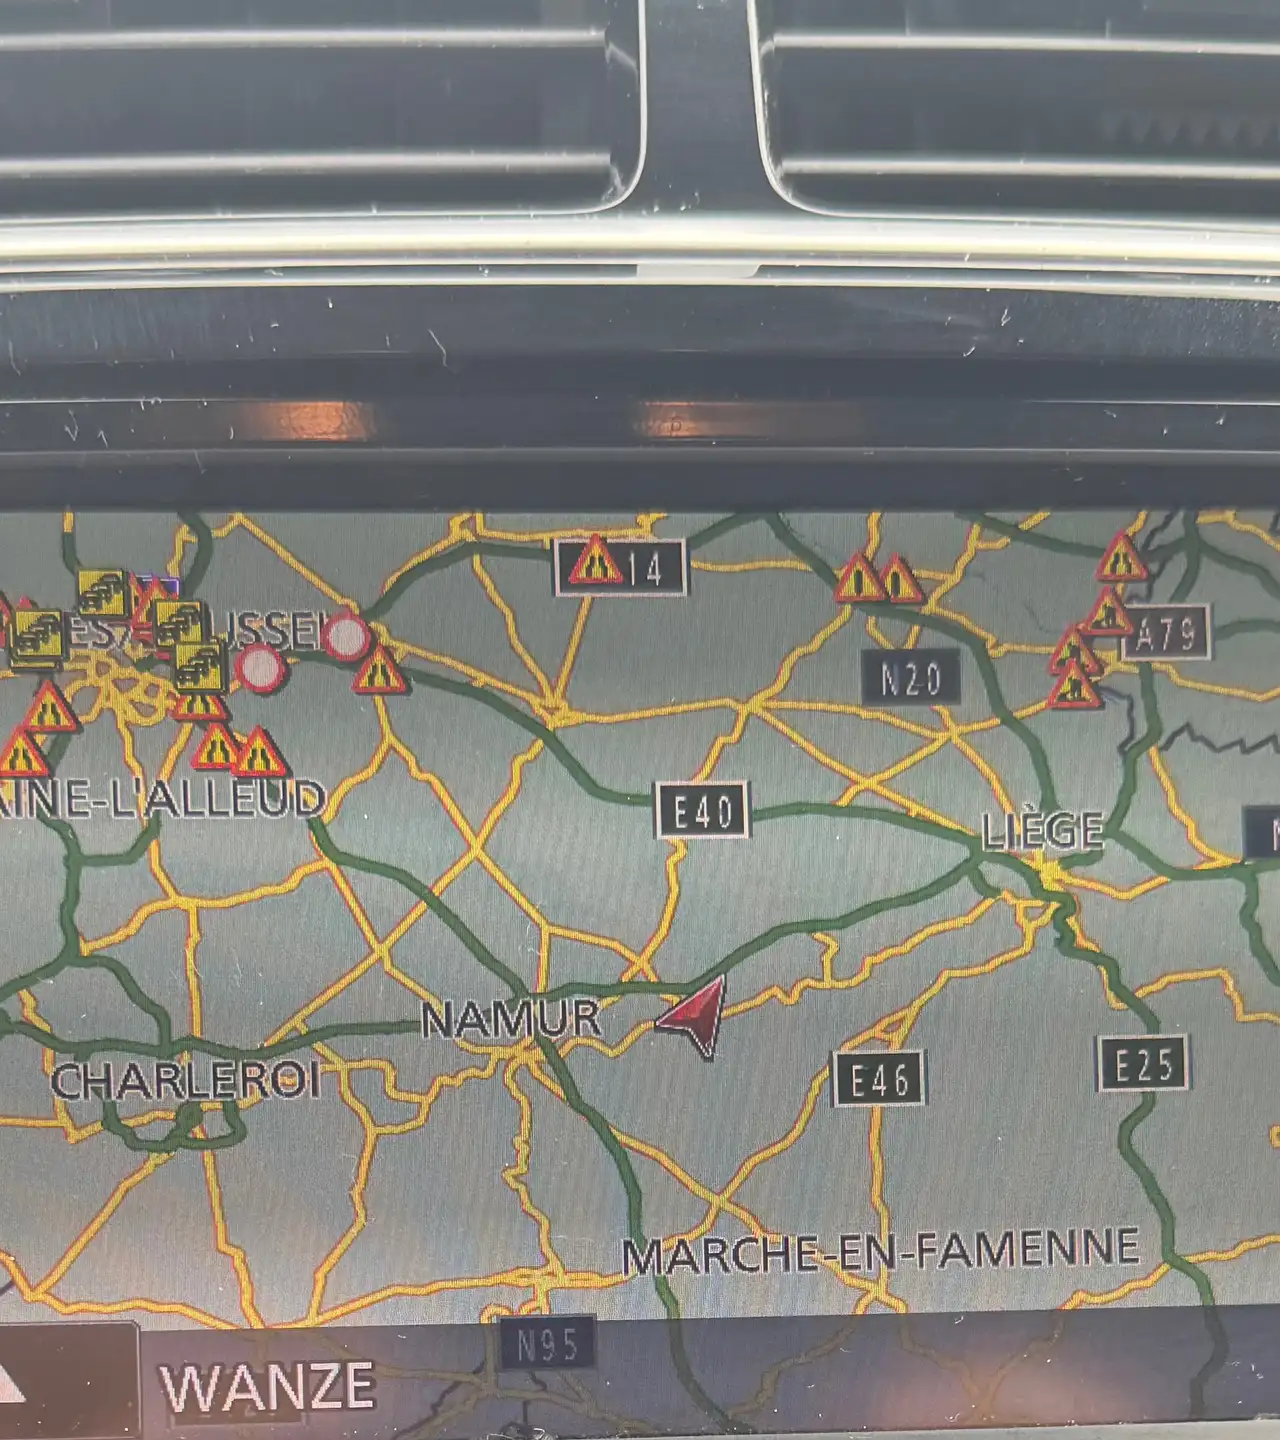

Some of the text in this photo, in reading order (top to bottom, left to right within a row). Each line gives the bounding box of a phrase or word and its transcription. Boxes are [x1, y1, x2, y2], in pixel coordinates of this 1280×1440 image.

[1135, 616, 1196, 652] A79
[880, 660, 942, 698] N20
[675, 794, 733, 830] E40
[981, 803, 1106, 852] LIÈGE
[421, 998, 602, 1039] NAMUR
[51, 1059, 320, 1100] CHARLEROI
[851, 1063, 908, 1099] E46
[1116, 1049, 1174, 1082] E25
[622, 1227, 1141, 1277] MARCHE-EN-FAMENNE
[518, 1325, 578, 1362] N95
[158, 1360, 376, 1413] WANZE
